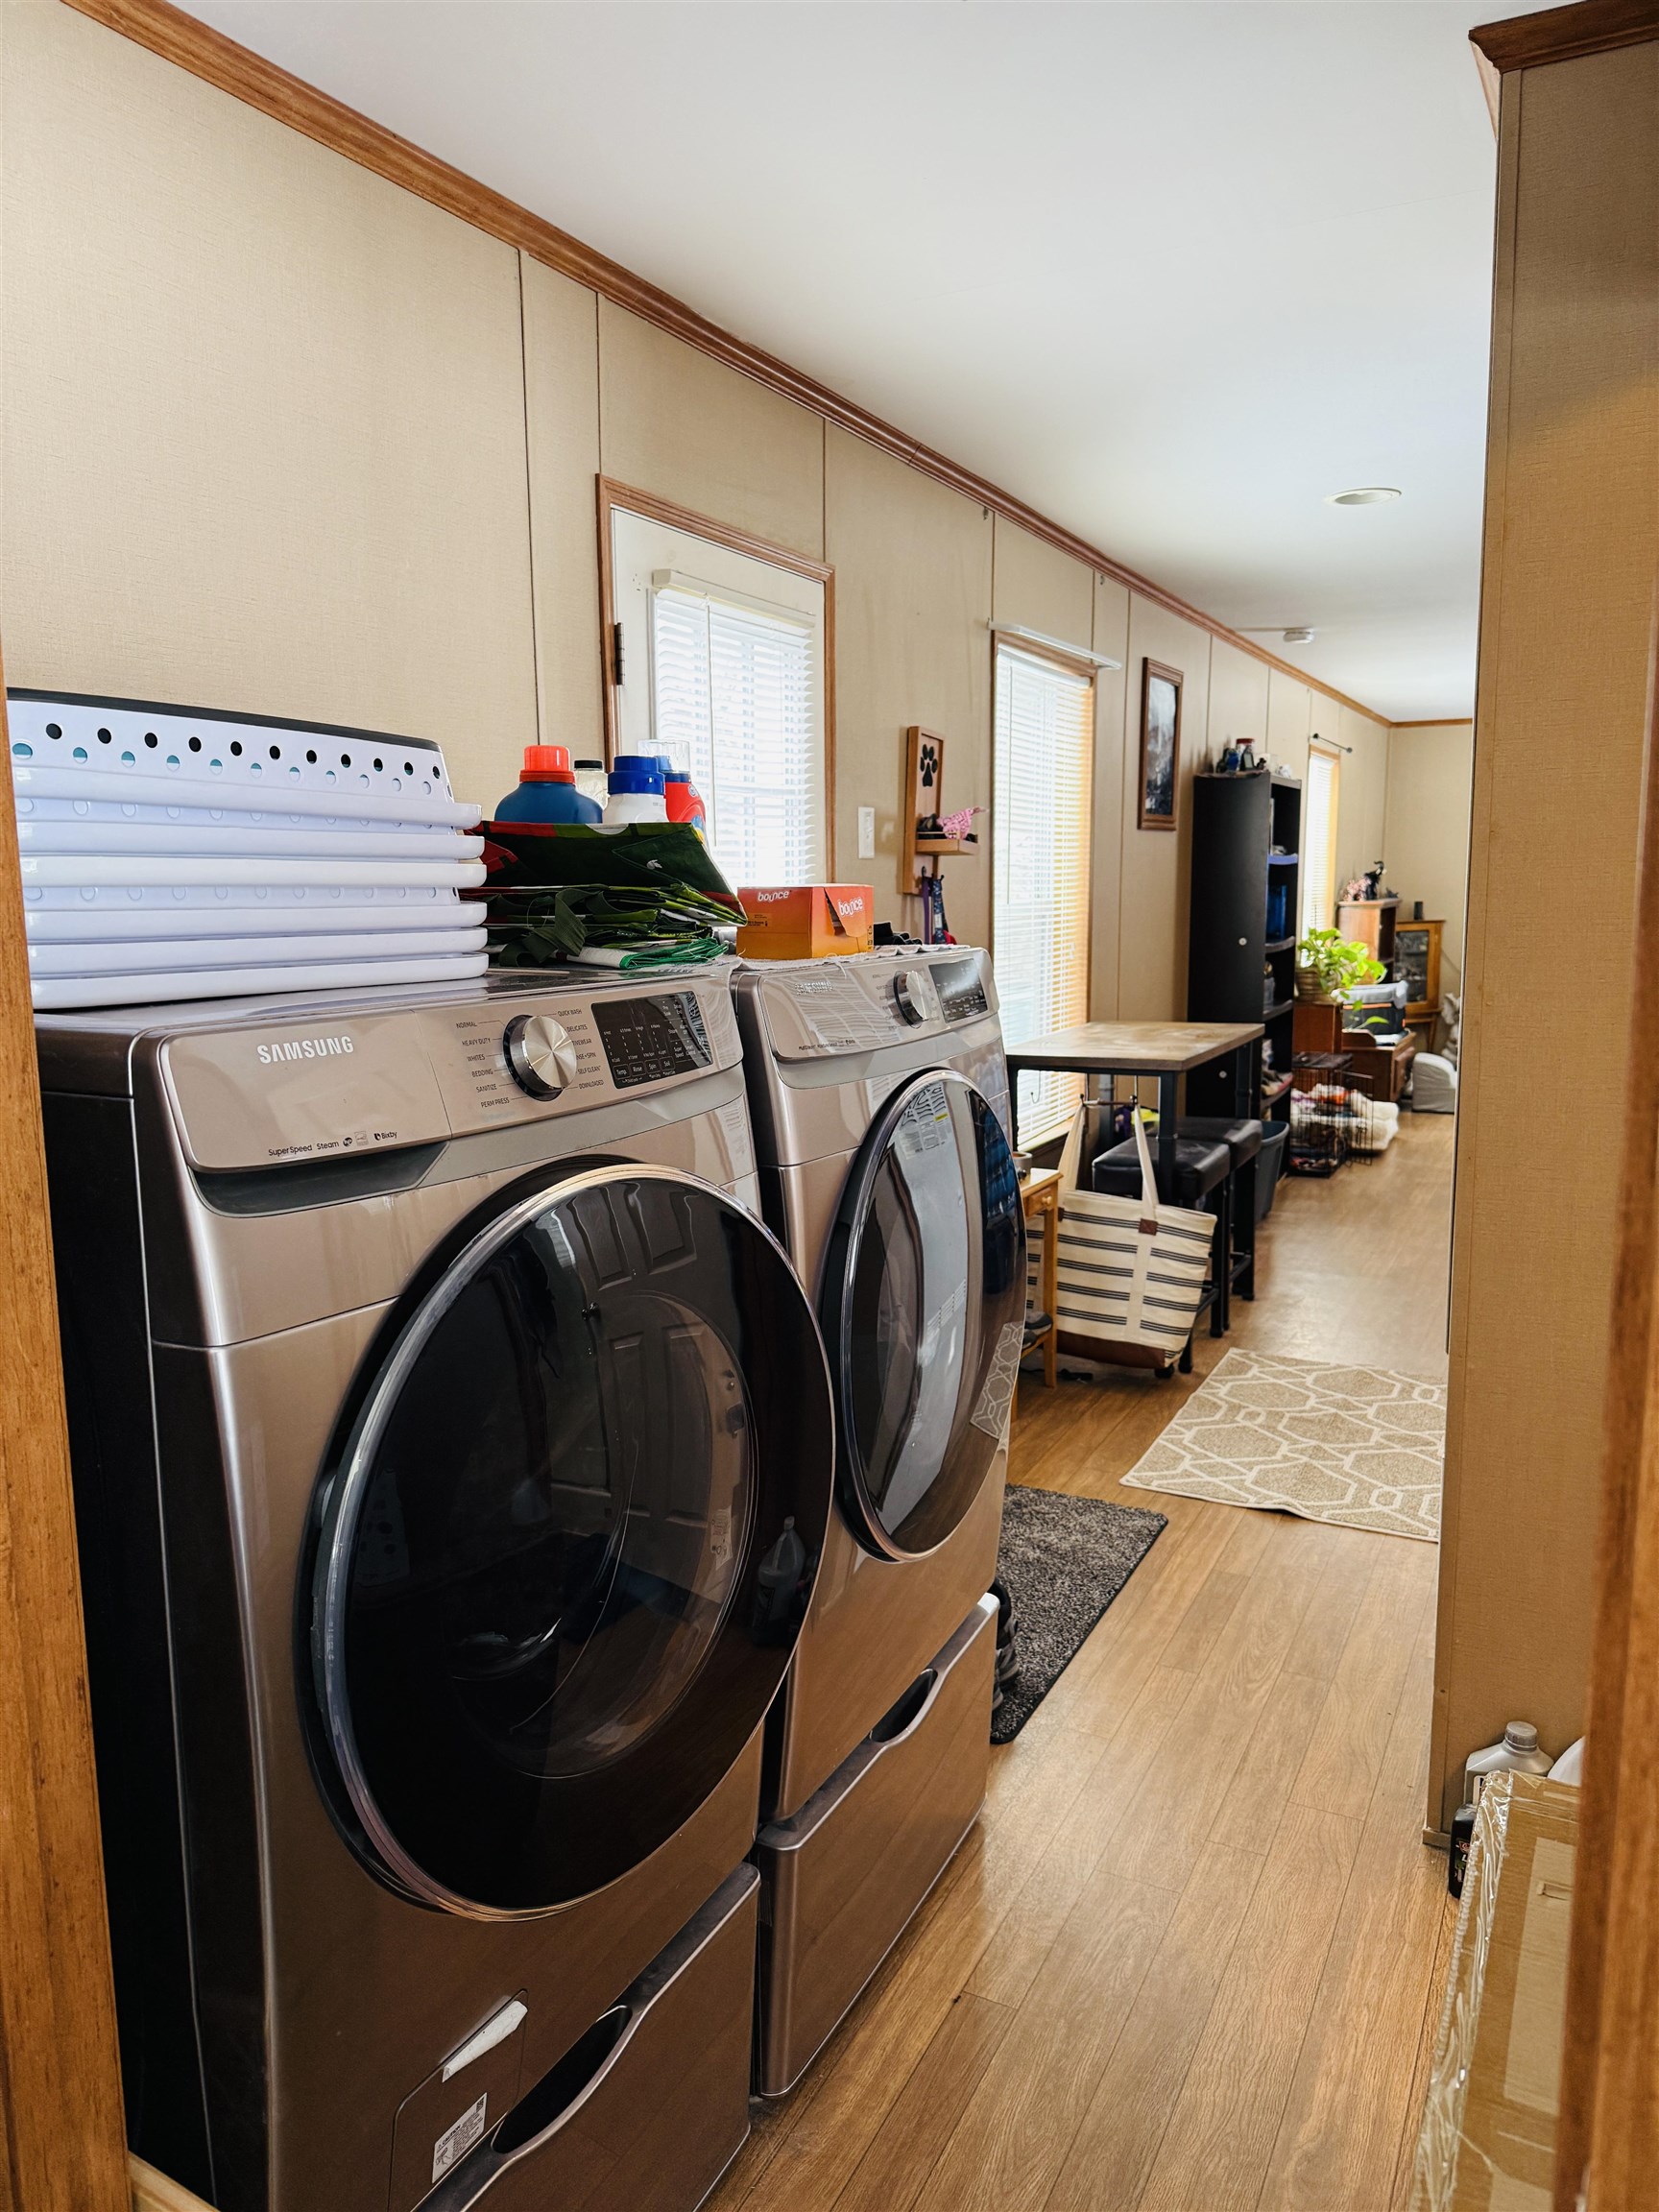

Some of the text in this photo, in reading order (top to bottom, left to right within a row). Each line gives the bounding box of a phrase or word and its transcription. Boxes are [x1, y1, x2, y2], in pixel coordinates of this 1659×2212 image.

[757, 890, 790, 902] bounce
[837, 896, 864, 918] bounce
[456, 1021, 478, 1029] NORMAL
[566, 1023, 589, 1033] DELICATES
[462, 1038, 479, 1046] HEAVY
[256, 1035, 354, 1064] SAMSUNG
[467, 1053, 486, 1063] WHITES
[471, 1068, 494, 1078] BEDDING
[476, 1083, 497, 1093] SANITIZE
[578, 1079, 604, 1090] DOWNLOADED
[480, 1096, 510, 1108] PERM PRESS
[381, 1131, 397, 1140] Bixby
[316, 1141, 340, 1150] Steam
